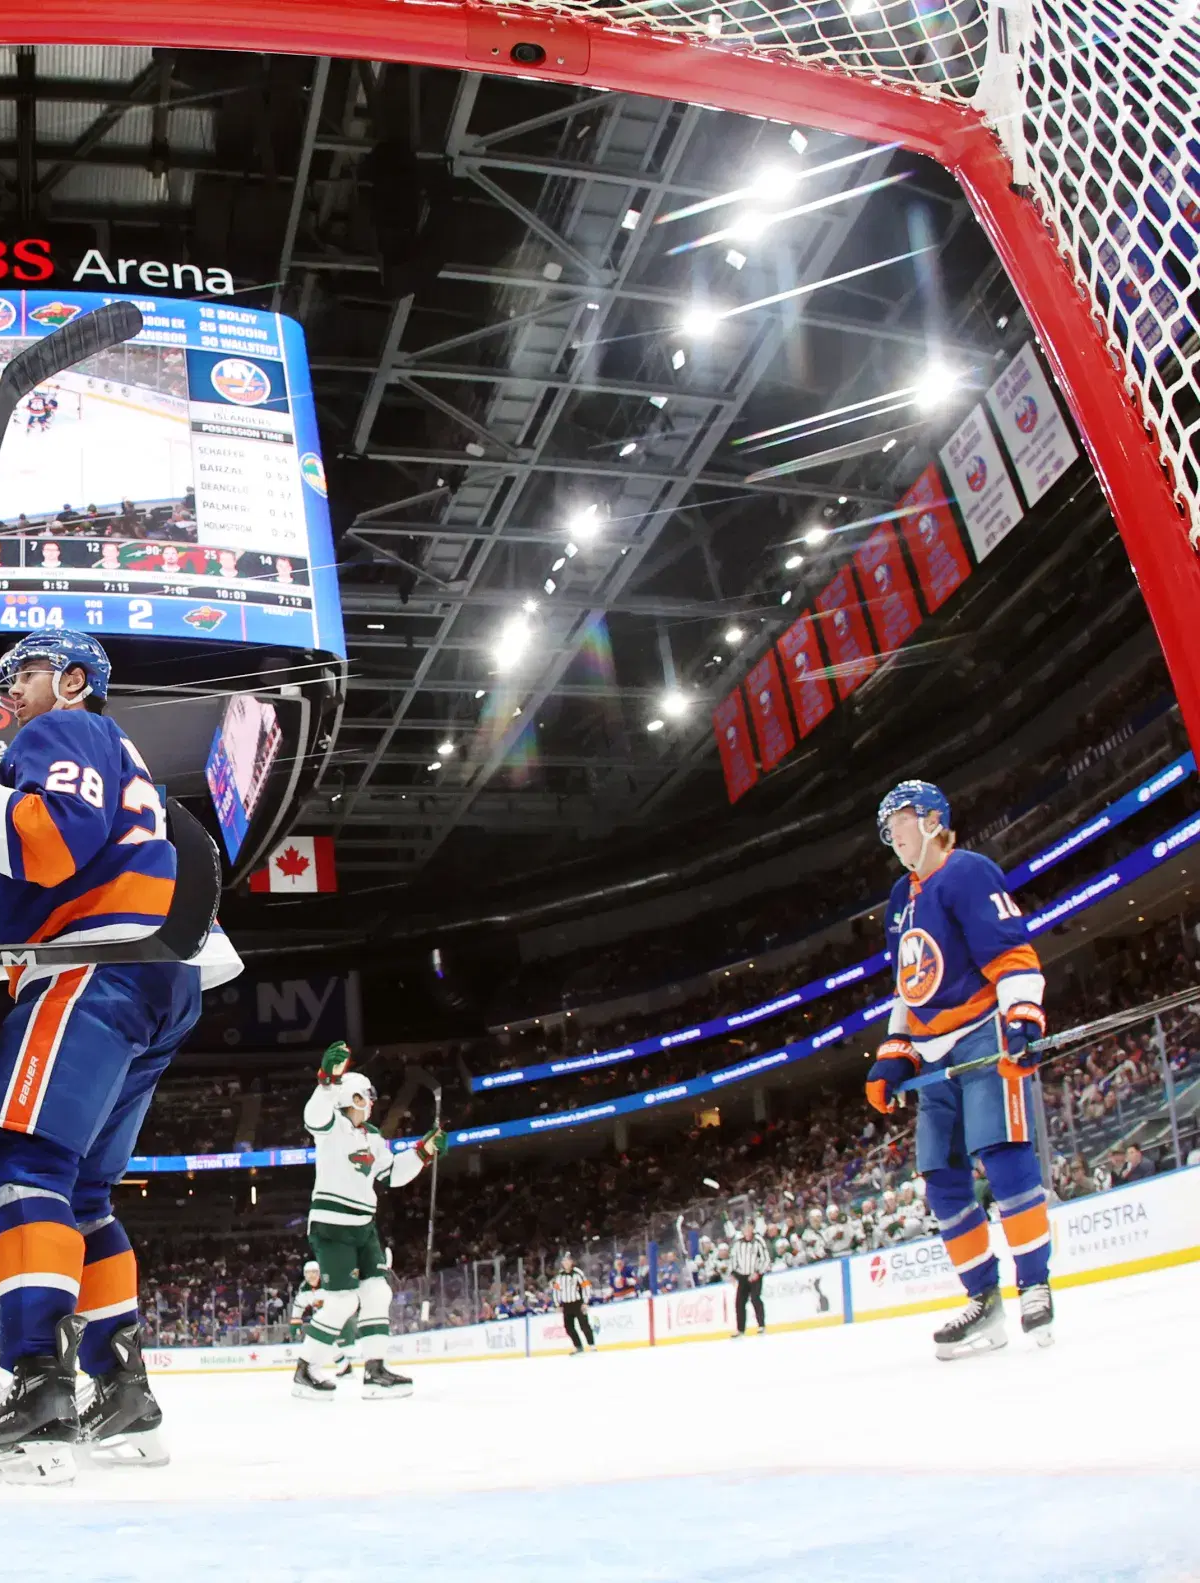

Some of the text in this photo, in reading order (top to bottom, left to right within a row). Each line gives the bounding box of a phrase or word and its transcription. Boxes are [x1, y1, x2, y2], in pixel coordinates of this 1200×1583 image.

[72, 249, 234, 296] Arena
[199, 307, 258, 324] 12 BOLDY
[219, 323, 268, 340] BRODIN
[220, 338, 279, 356] WALLSTEDT
[202, 423, 284, 442] POSSESSION TIME
[30, 542, 38, 551] 7
[86, 543, 100, 552] 12
[204, 549, 217, 560] 25
[259, 555, 272, 566] 14
[42, 581, 70, 590] 9:52
[103, 582, 130, 592] 7:15
[278, 595, 303, 606] 7:12
[86, 610, 103, 625] 11
[128, 599, 154, 630] 2
[45, 760, 104, 808] 28
[18, 1056, 39, 1107] BAUER
[575, 1110, 588, 1120] Best
[468, 1127, 501, 1140] HYUNDAI
[187, 1160, 222, 1170] SECTION
[1068, 1202, 1148, 1238] HOFSTRA
[1070, 1229, 1150, 1256] UNIVERSITY
[891, 1244, 946, 1269] GLOB
[892, 1263, 950, 1284] INDUSTR
